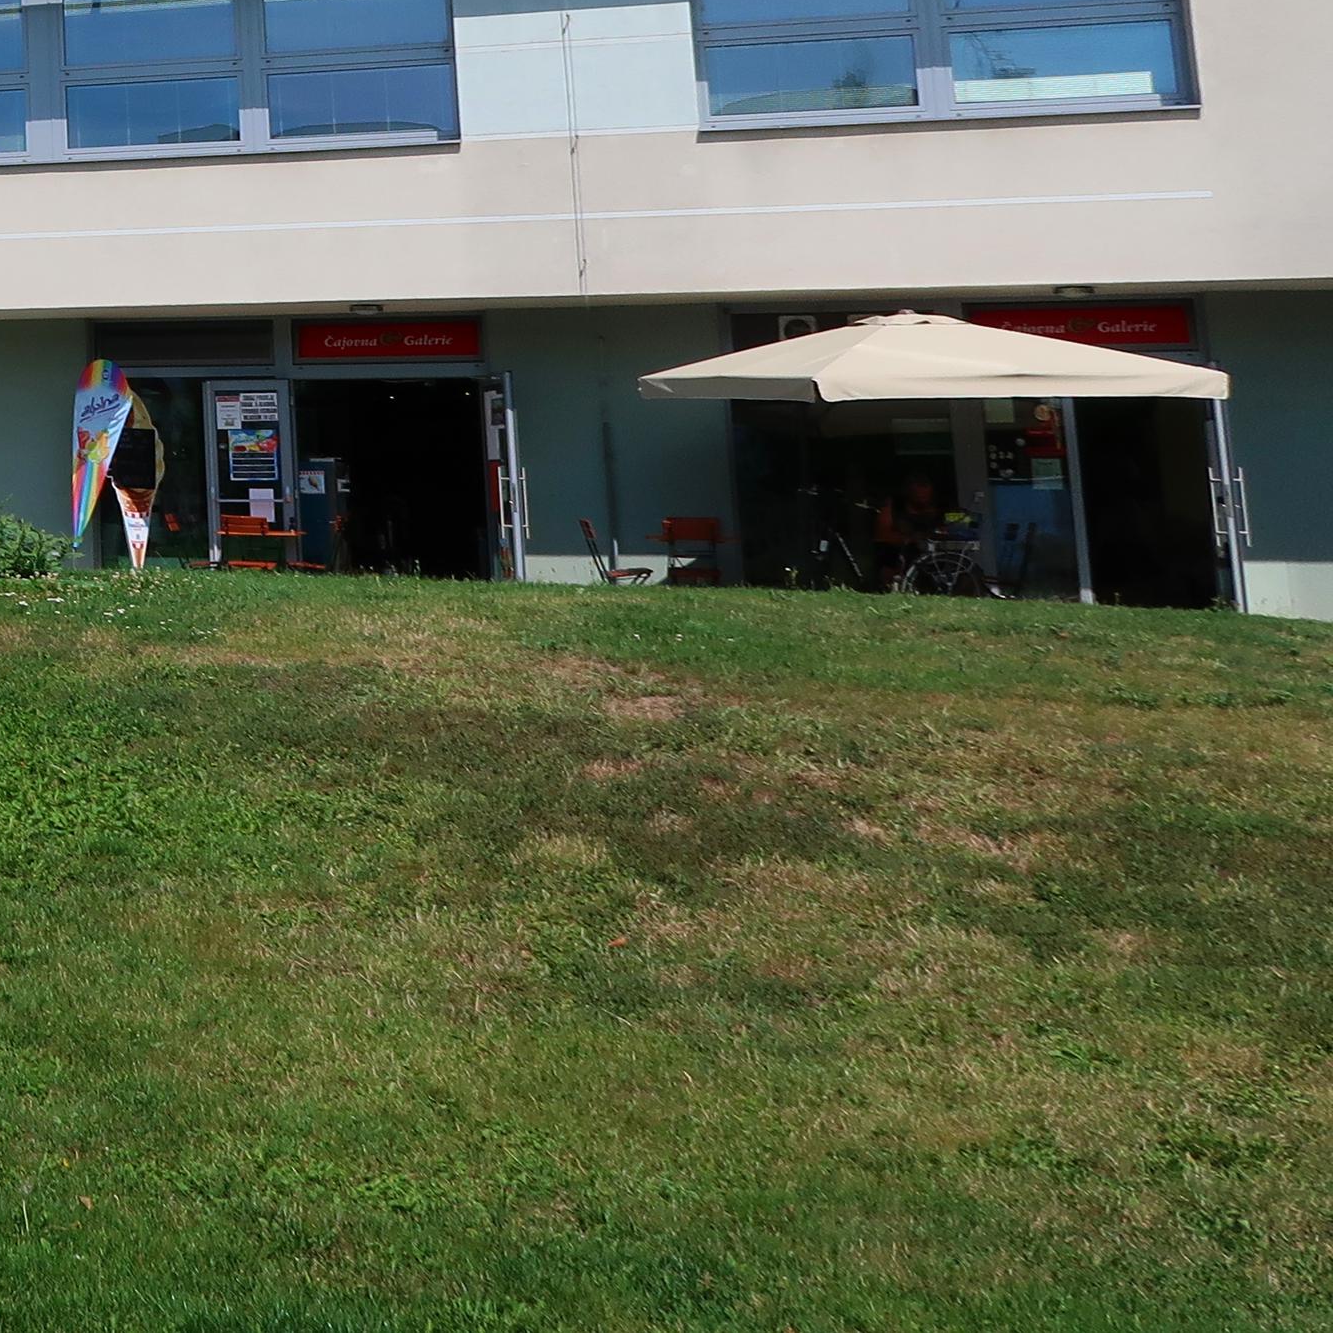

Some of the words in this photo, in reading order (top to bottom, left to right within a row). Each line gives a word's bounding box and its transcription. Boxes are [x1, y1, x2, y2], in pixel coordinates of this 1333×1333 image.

[1097, 320, 1157, 333] Galerie
[324, 335, 378, 350] Čajovna
[403, 334, 453, 346] Galerie
